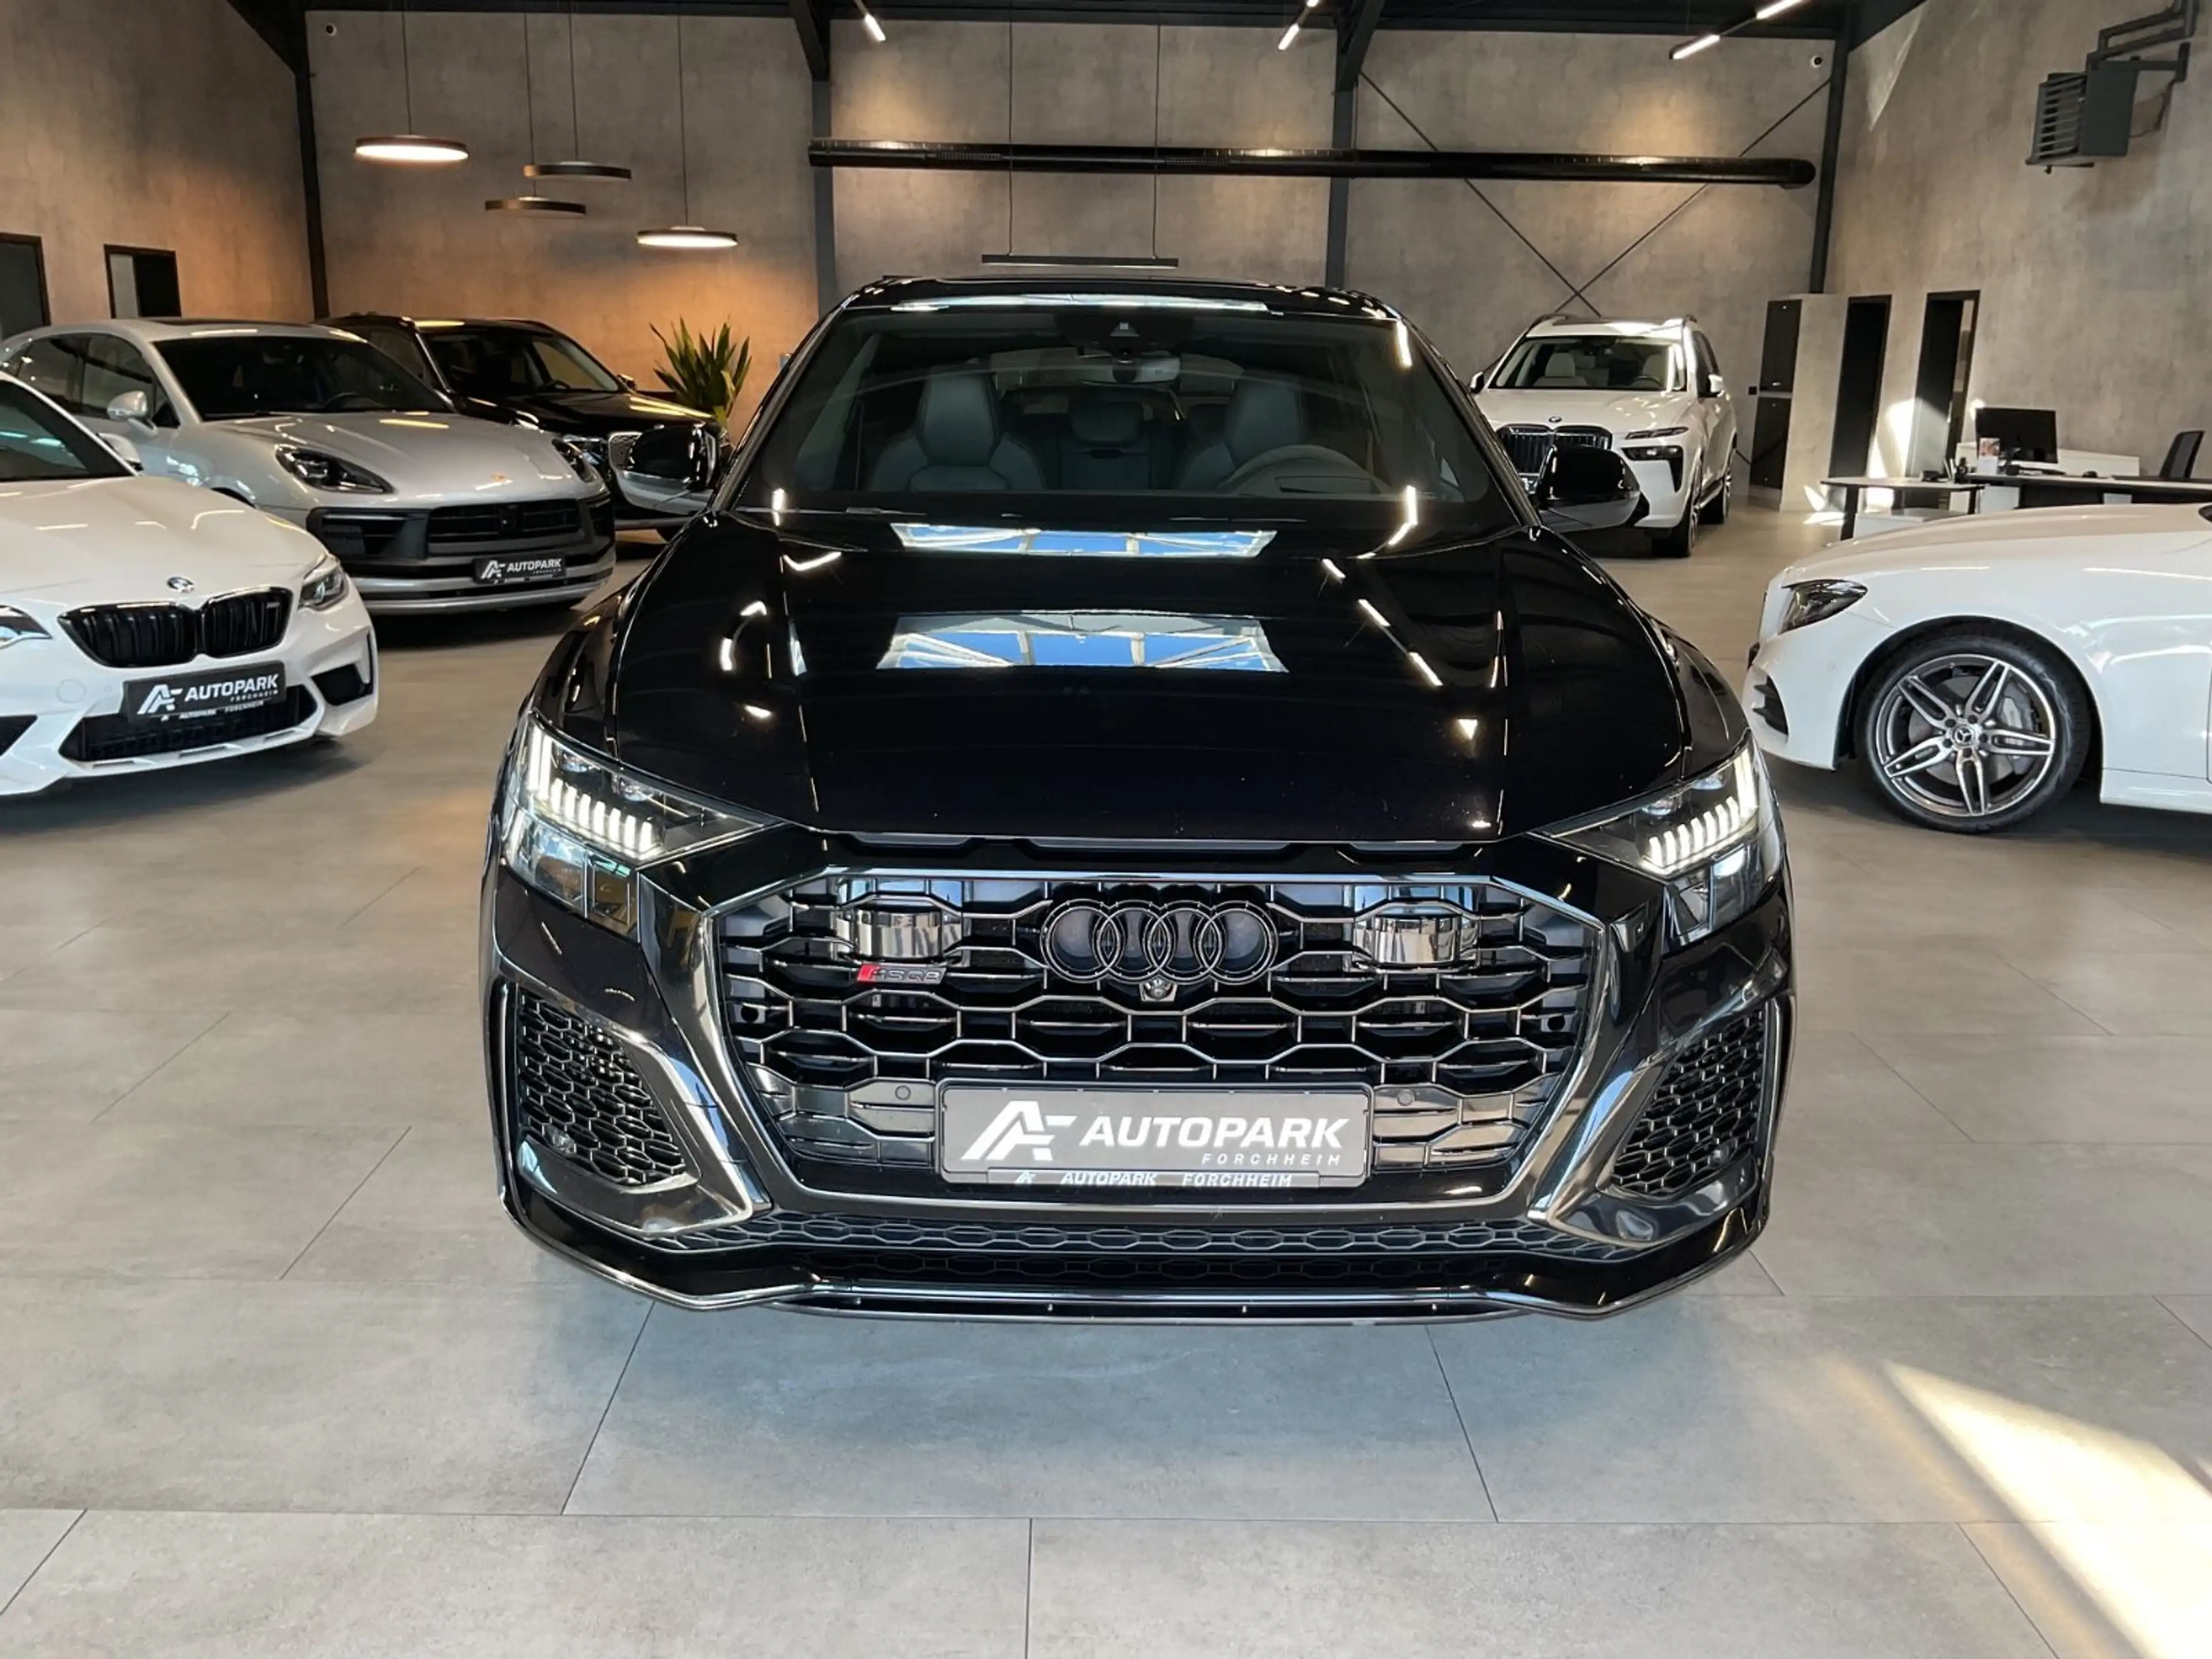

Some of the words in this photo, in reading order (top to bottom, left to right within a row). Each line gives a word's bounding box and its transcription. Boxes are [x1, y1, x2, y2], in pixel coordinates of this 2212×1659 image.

[506, 558, 562, 572] AUTOPARK
[184, 673, 279, 702] AUTOPARK
[1079, 1116, 1350, 1149] AUTOPARK
[1201, 1153, 1341, 1166] FORCHHEIM
[1060, 1172, 1159, 1186] AUTOPARK
[1181, 1173, 1293, 1187] FORCHHEIM
